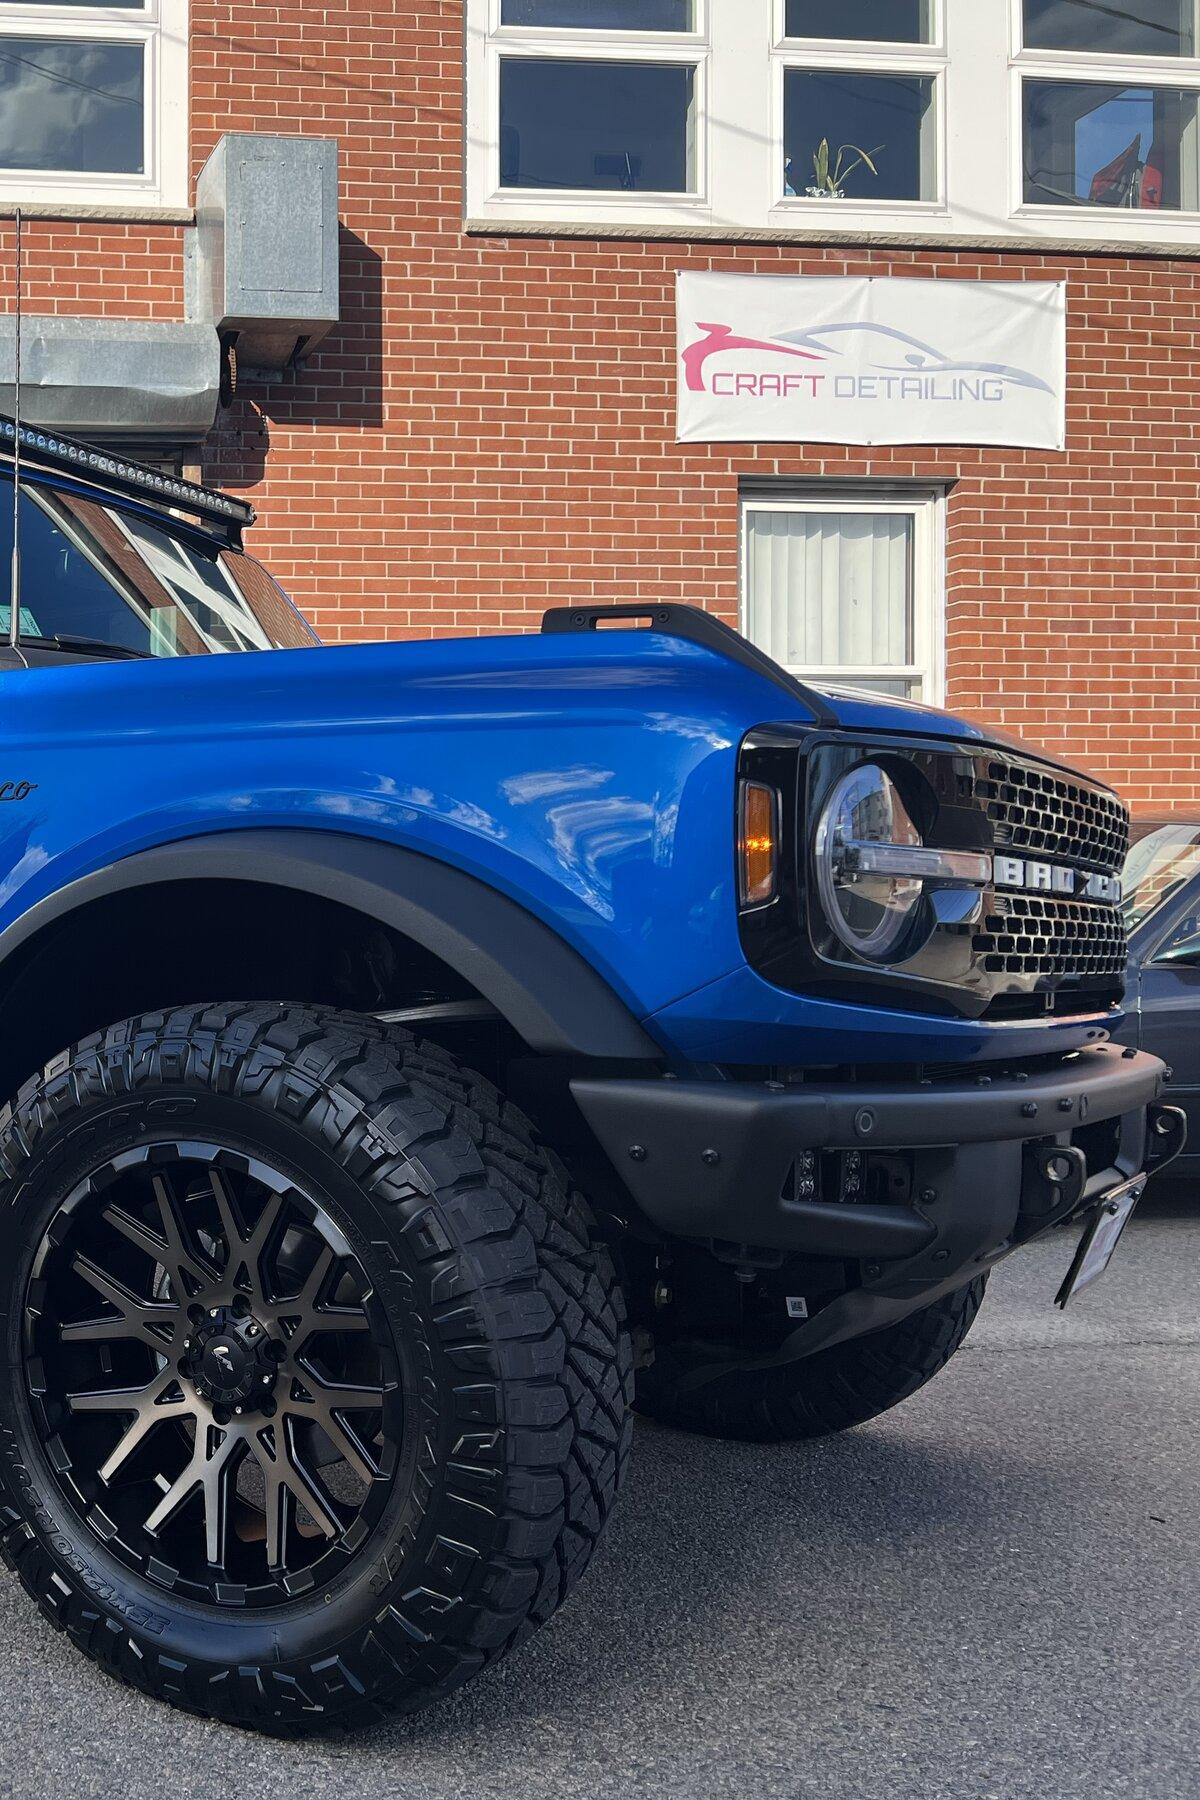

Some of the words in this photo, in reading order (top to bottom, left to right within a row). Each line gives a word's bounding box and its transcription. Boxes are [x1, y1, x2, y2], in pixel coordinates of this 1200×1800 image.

[712, 373, 825, 398] CRAFT
[834, 375, 1004, 401] DETAILING
[994, 855, 1122, 901] BROC
